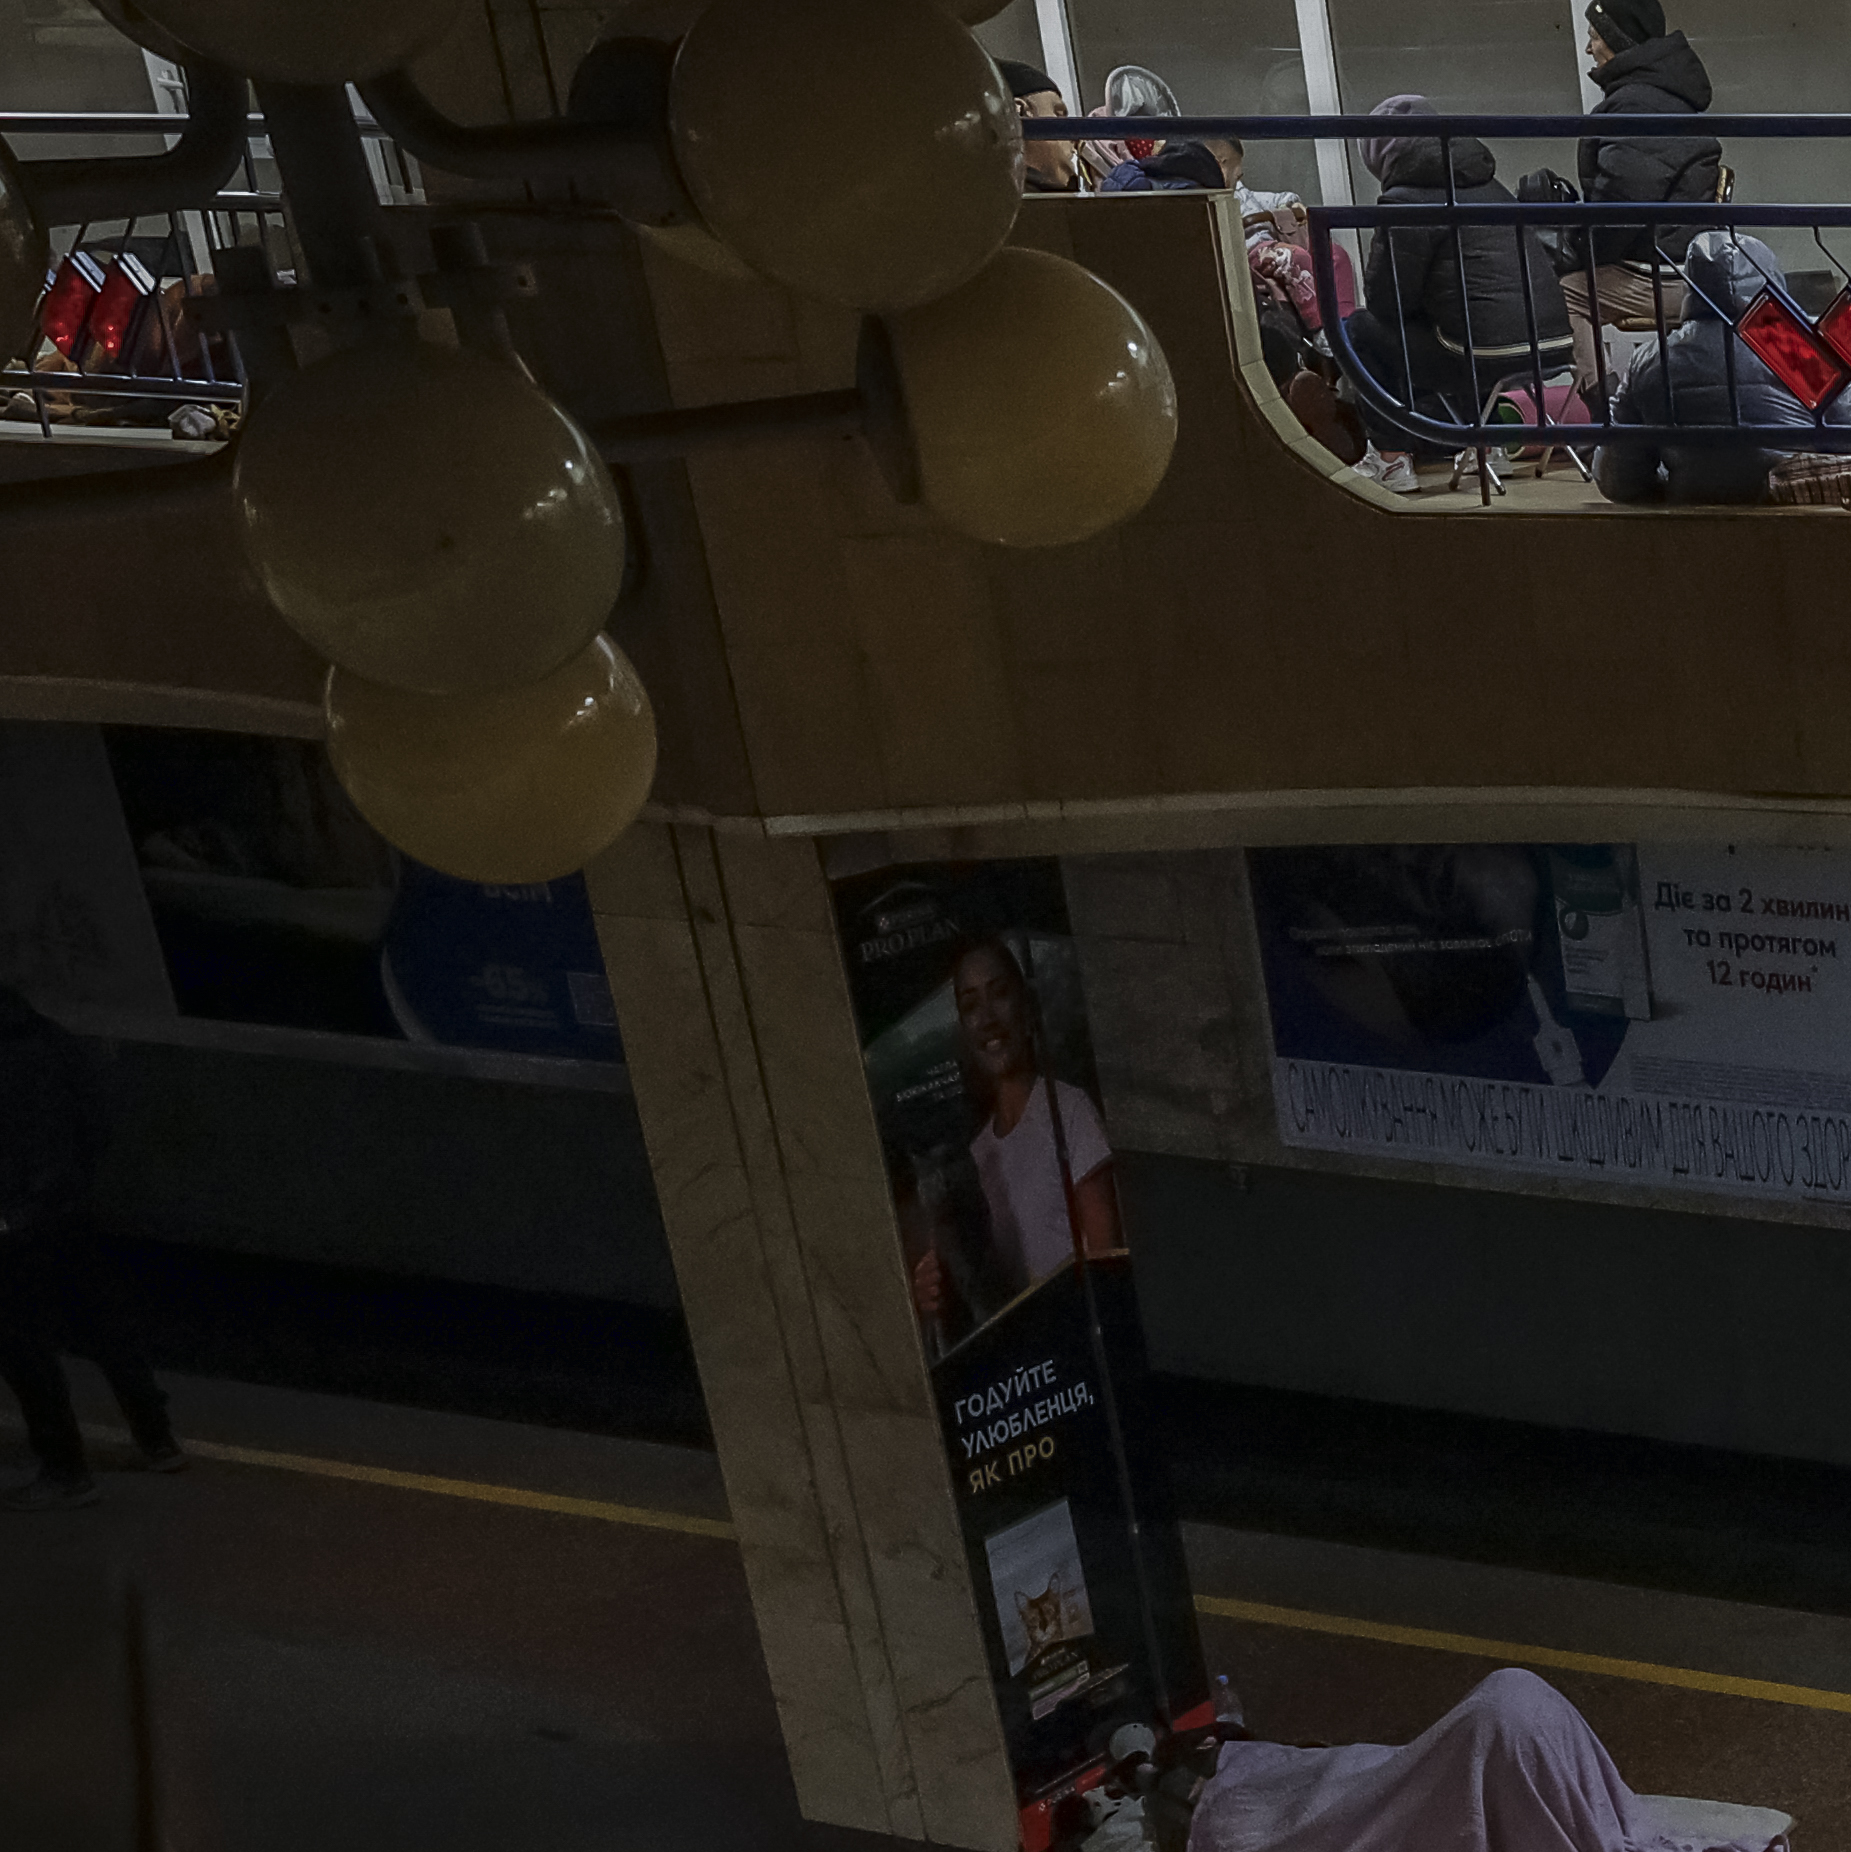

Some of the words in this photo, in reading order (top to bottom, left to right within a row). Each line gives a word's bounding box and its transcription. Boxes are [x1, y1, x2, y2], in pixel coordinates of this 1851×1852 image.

[1654, 881, 1695, 911] Діє
[1702, 893, 1732, 912] за
[1738, 887, 1755, 912] 2
[1683, 927, 1711, 947] та
[1720, 930, 1837, 961] протягом
[1707, 961, 1733, 986] 12
[1440, 1079, 1505, 1155] МОЖЕ
[1668, 1102, 1708, 1175] ДЛЯ
[1707, 1106, 1796, 1186] ВАШОГО
[953, 1358, 1058, 1426] ГОДУЙТЕ
[960, 1380, 1096, 1459] УЛЮБЛЕНЦЯ,
[968, 1461, 1001, 1494] ЯК
[1006, 1435, 1056, 1476] ПРО
